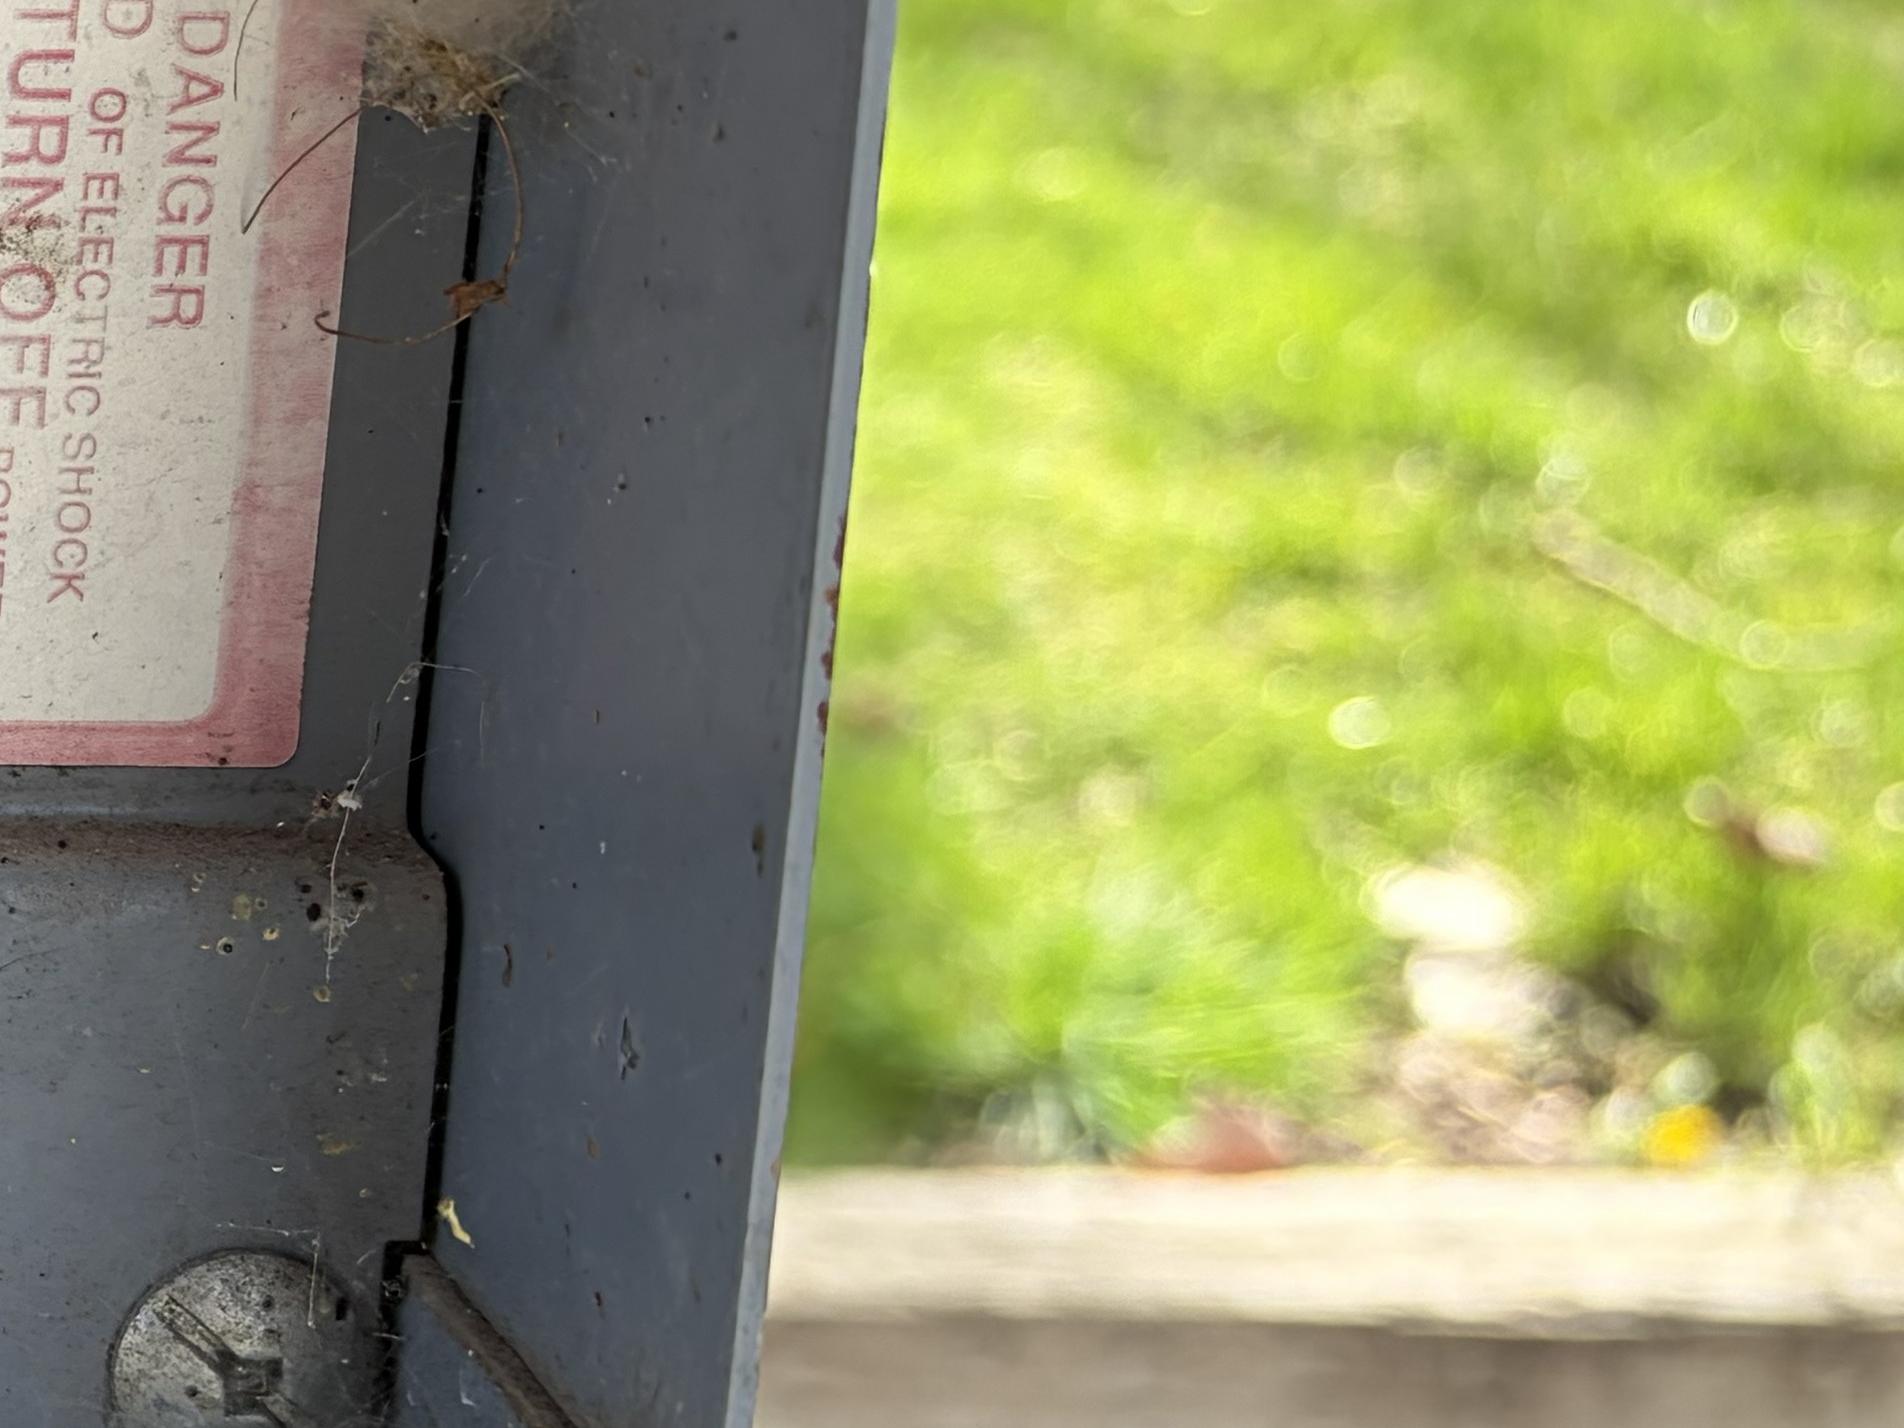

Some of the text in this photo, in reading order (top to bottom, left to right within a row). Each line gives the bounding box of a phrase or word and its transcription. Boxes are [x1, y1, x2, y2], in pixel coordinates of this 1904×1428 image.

[86, 87, 128, 156] OF
[147, 11, 231, 329] DANGER
[64, 172, 120, 417] ELECTRIC
[47, 432, 97, 603] SHOCK
